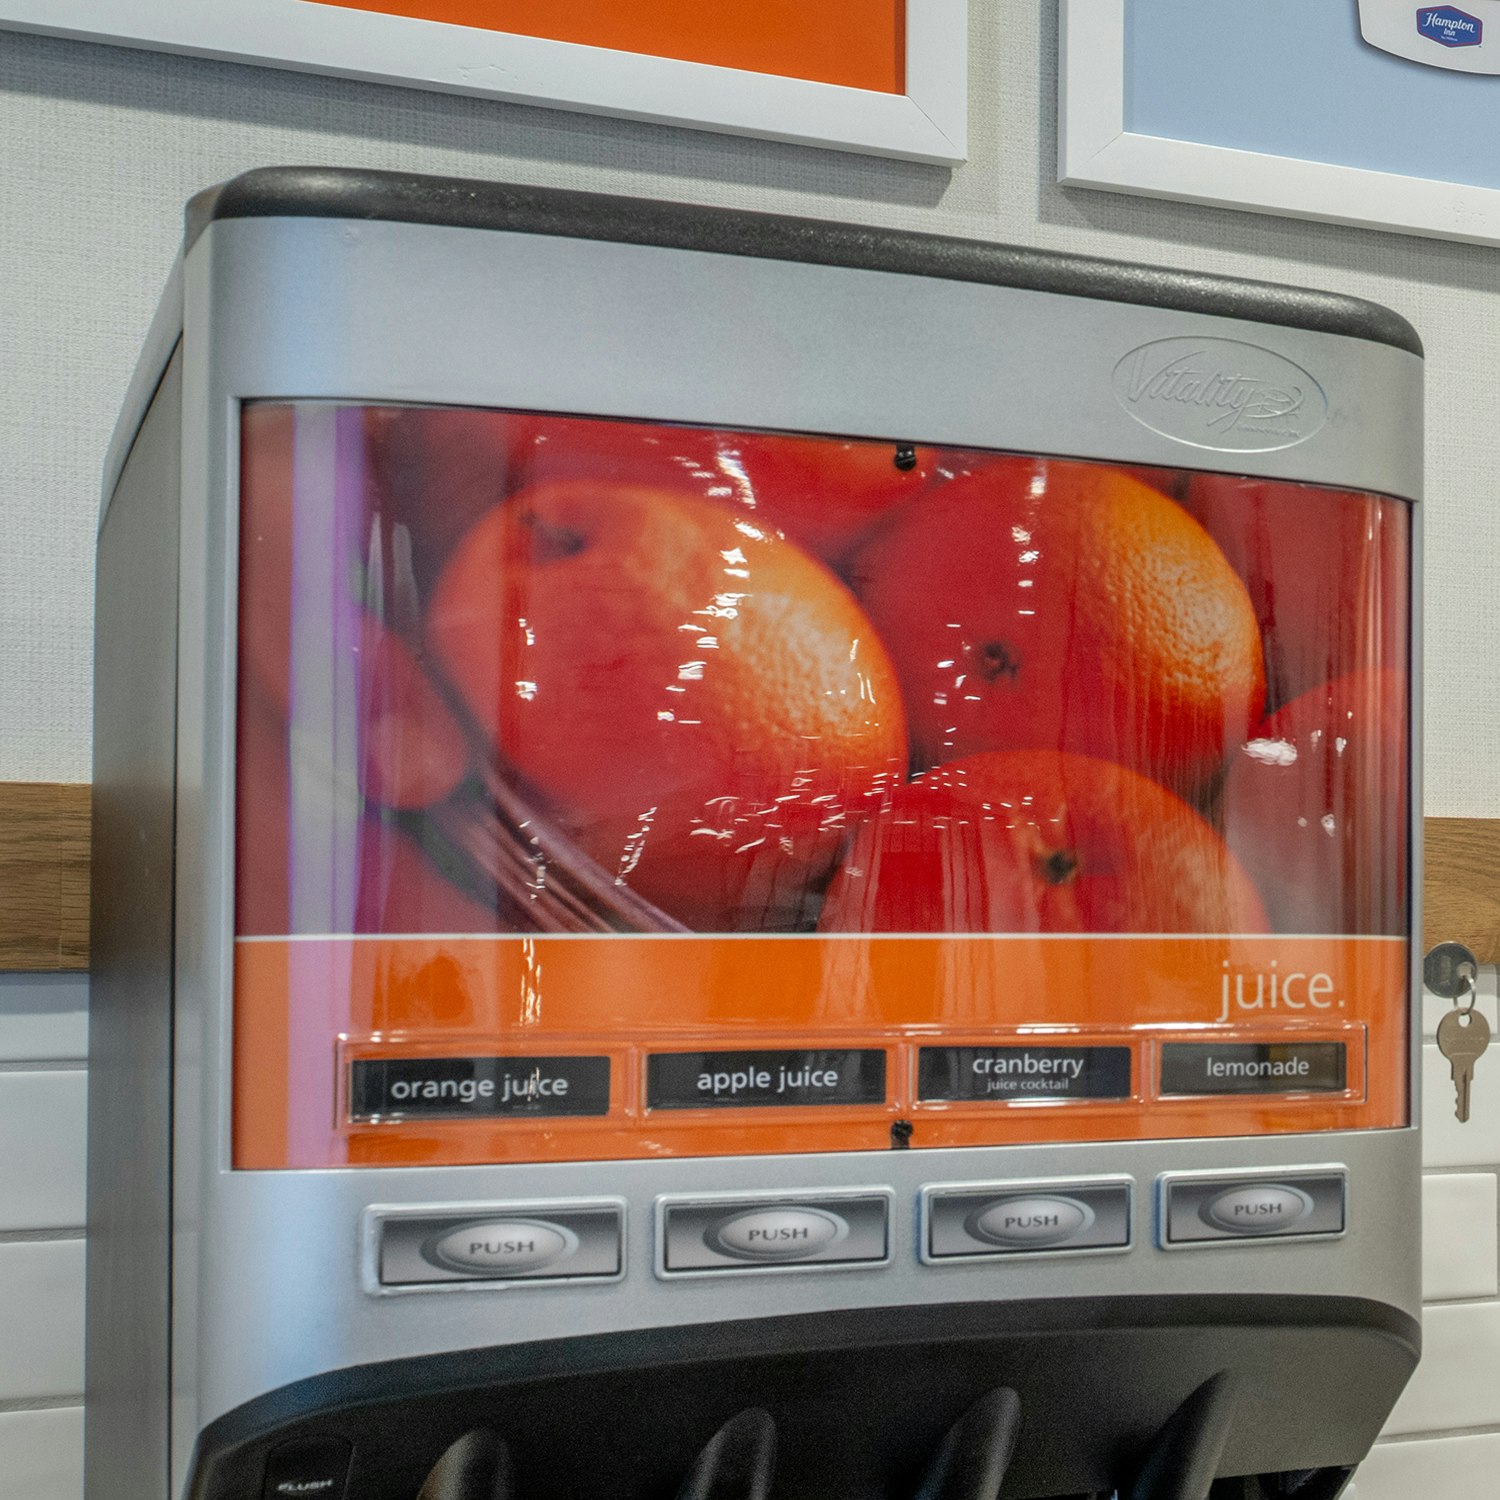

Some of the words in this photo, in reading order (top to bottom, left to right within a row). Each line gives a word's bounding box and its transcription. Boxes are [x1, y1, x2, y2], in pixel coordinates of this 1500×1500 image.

[1422, 12, 1476, 33] Hampton
[1443, 28, 1456, 36] Inn
[1127, 350, 1266, 434] Vitality
[1216, 959, 1345, 1023] juice.
[972, 1053, 1084, 1078] cranberry
[1206, 1057, 1310, 1076] lemonade
[391, 1079, 495, 1102] orange
[501, 1073, 568, 1102] juice
[697, 1066, 771, 1094] apple
[777, 1066, 838, 1092] juice
[986, 1078, 1018, 1093] juice
[1020, 1078, 1069, 1090] cocktail
[1234, 1202, 1283, 1217] PUSH
[1005, 1214, 1059, 1229] PUSH
[748, 1226, 808, 1242] PUSH
[470, 1240, 534, 1255] PUSH
[278, 1479, 333, 1491] FLUSH
